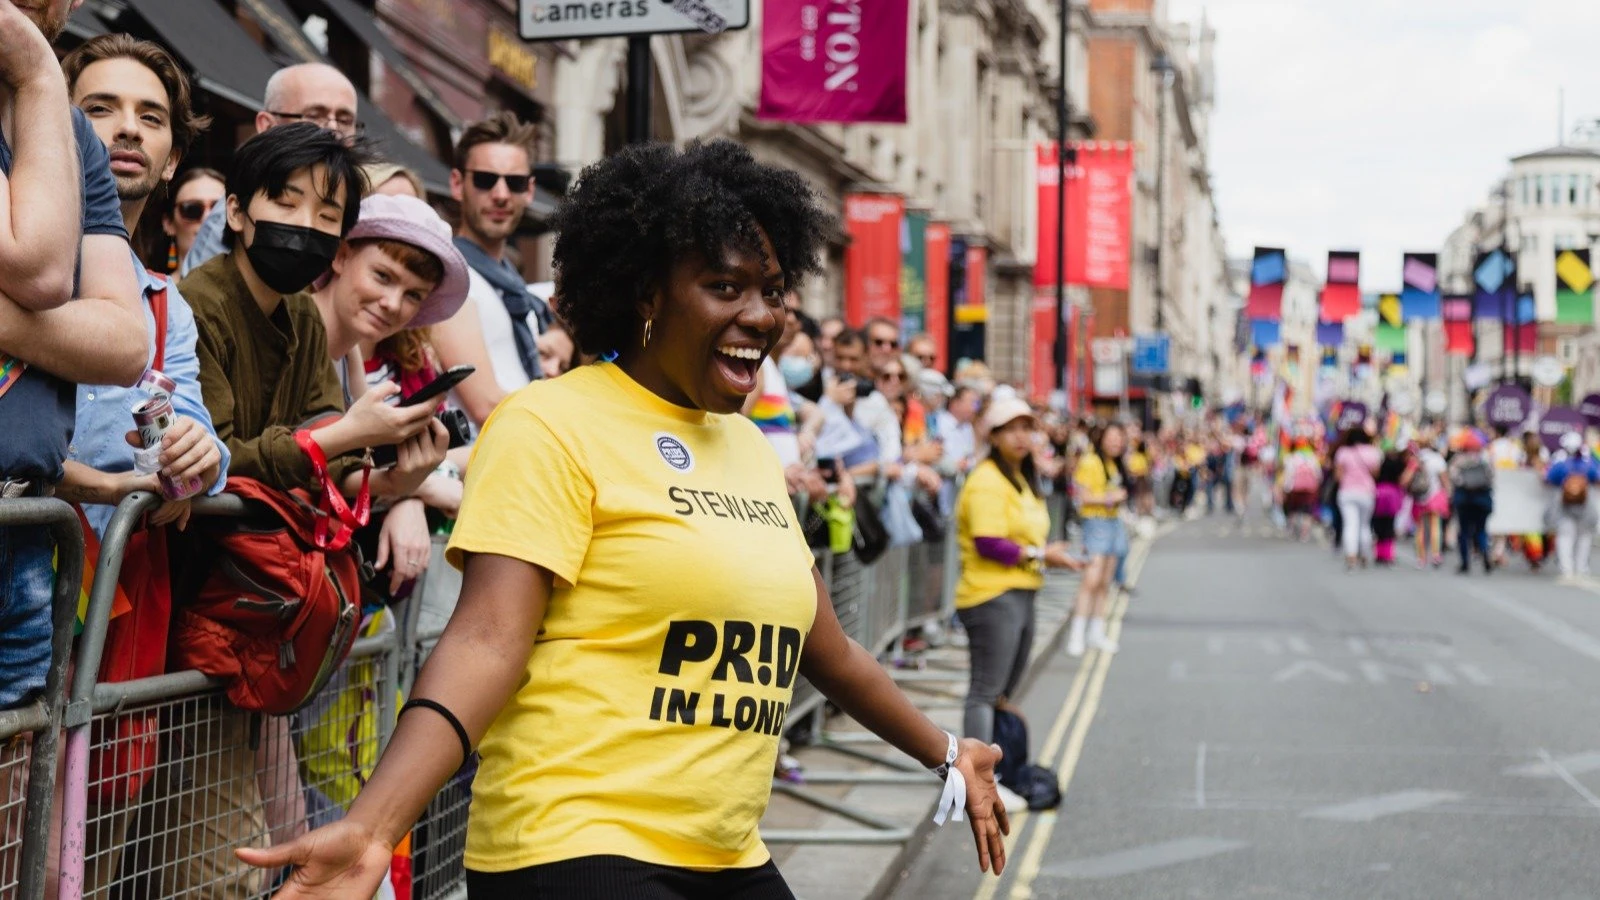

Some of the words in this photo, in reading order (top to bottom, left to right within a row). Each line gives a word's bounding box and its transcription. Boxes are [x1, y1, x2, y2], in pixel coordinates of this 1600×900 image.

[532, 0, 648, 22] cameras
[823, 0, 862, 92] TON
[669, 486, 788, 528] STEWARD
[658, 620, 808, 689] PR!D
[649, 687, 700, 726] IN
[711, 693, 789, 736] LOND
